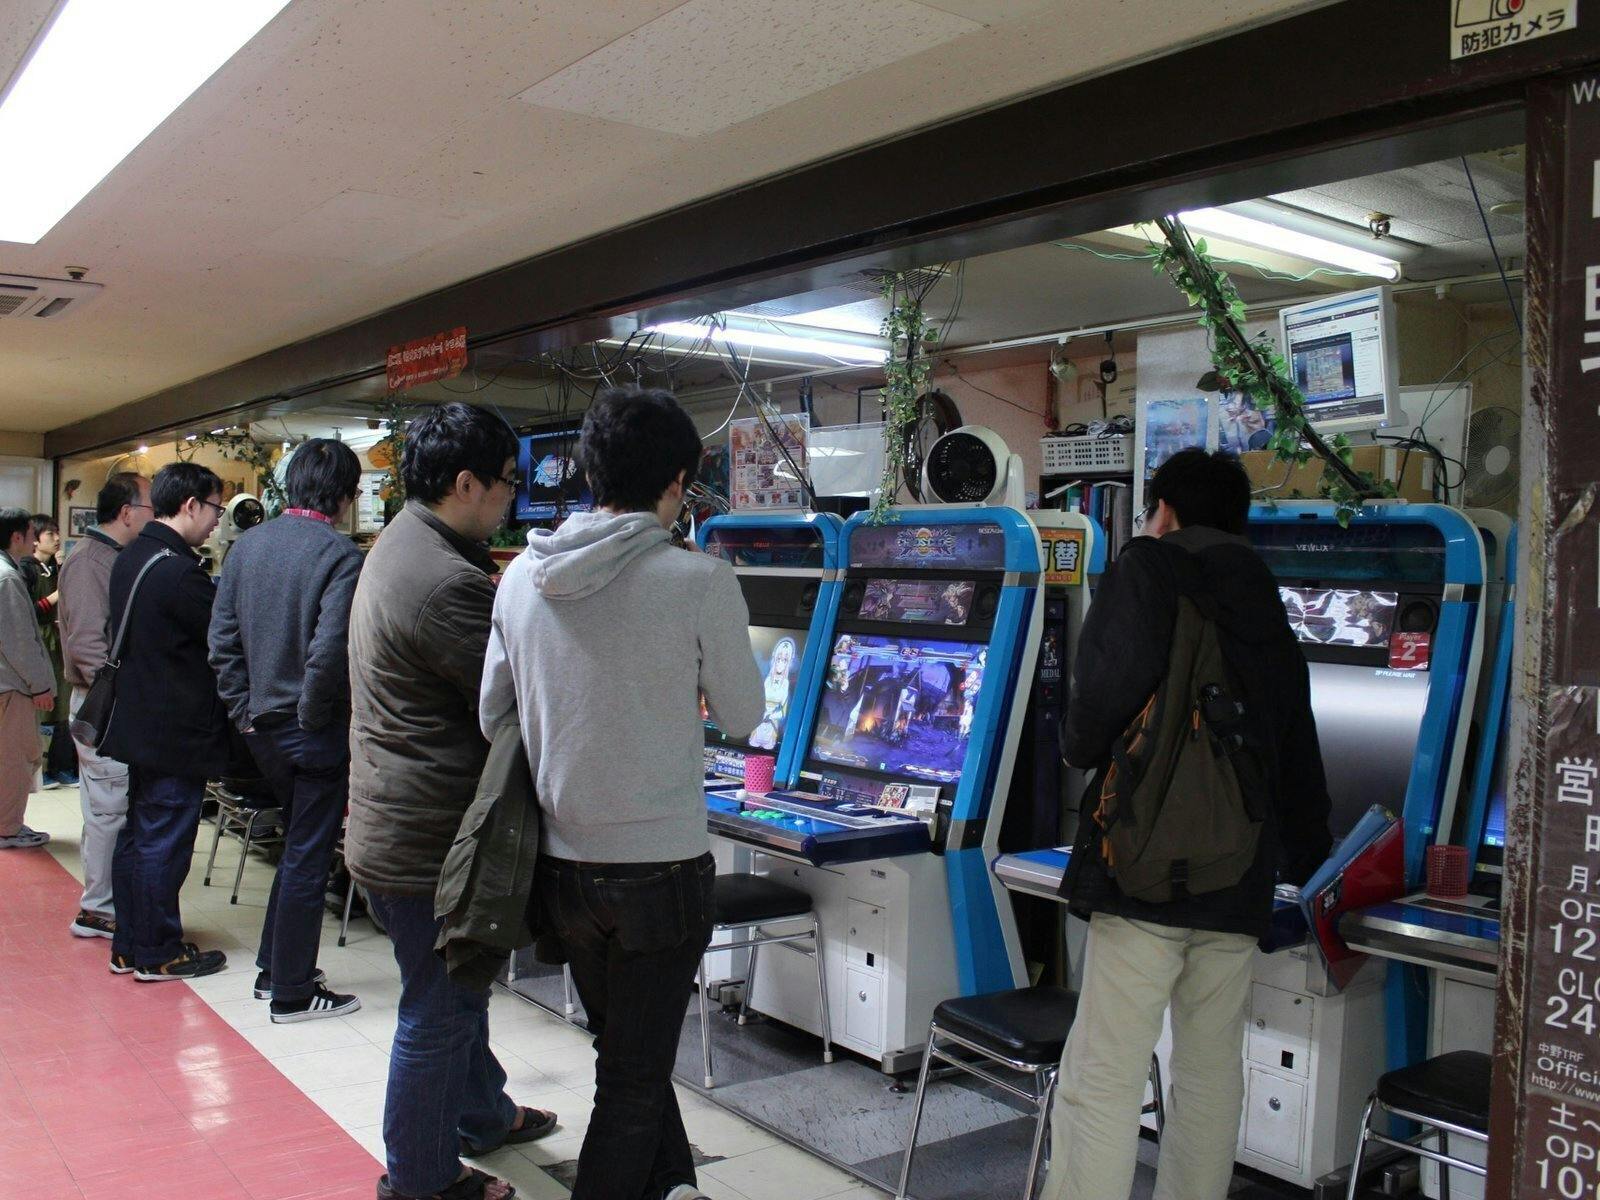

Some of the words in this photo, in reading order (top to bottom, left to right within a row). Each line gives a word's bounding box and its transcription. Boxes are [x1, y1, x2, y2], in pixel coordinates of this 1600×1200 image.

[1461, 9, 1565, 55] 防犯カメラ
[1573, 79, 1600, 104] W
[1401, 641, 1416, 661] 2
[1556, 757, 1597, 806] 営
[1567, 865, 1600, 893] 月
[1550, 922, 1597, 961] 12
[1545, 996, 1597, 1035] 24
[1537, 1057, 1600, 1086] Offici
[1546, 1135, 1600, 1164] OP
